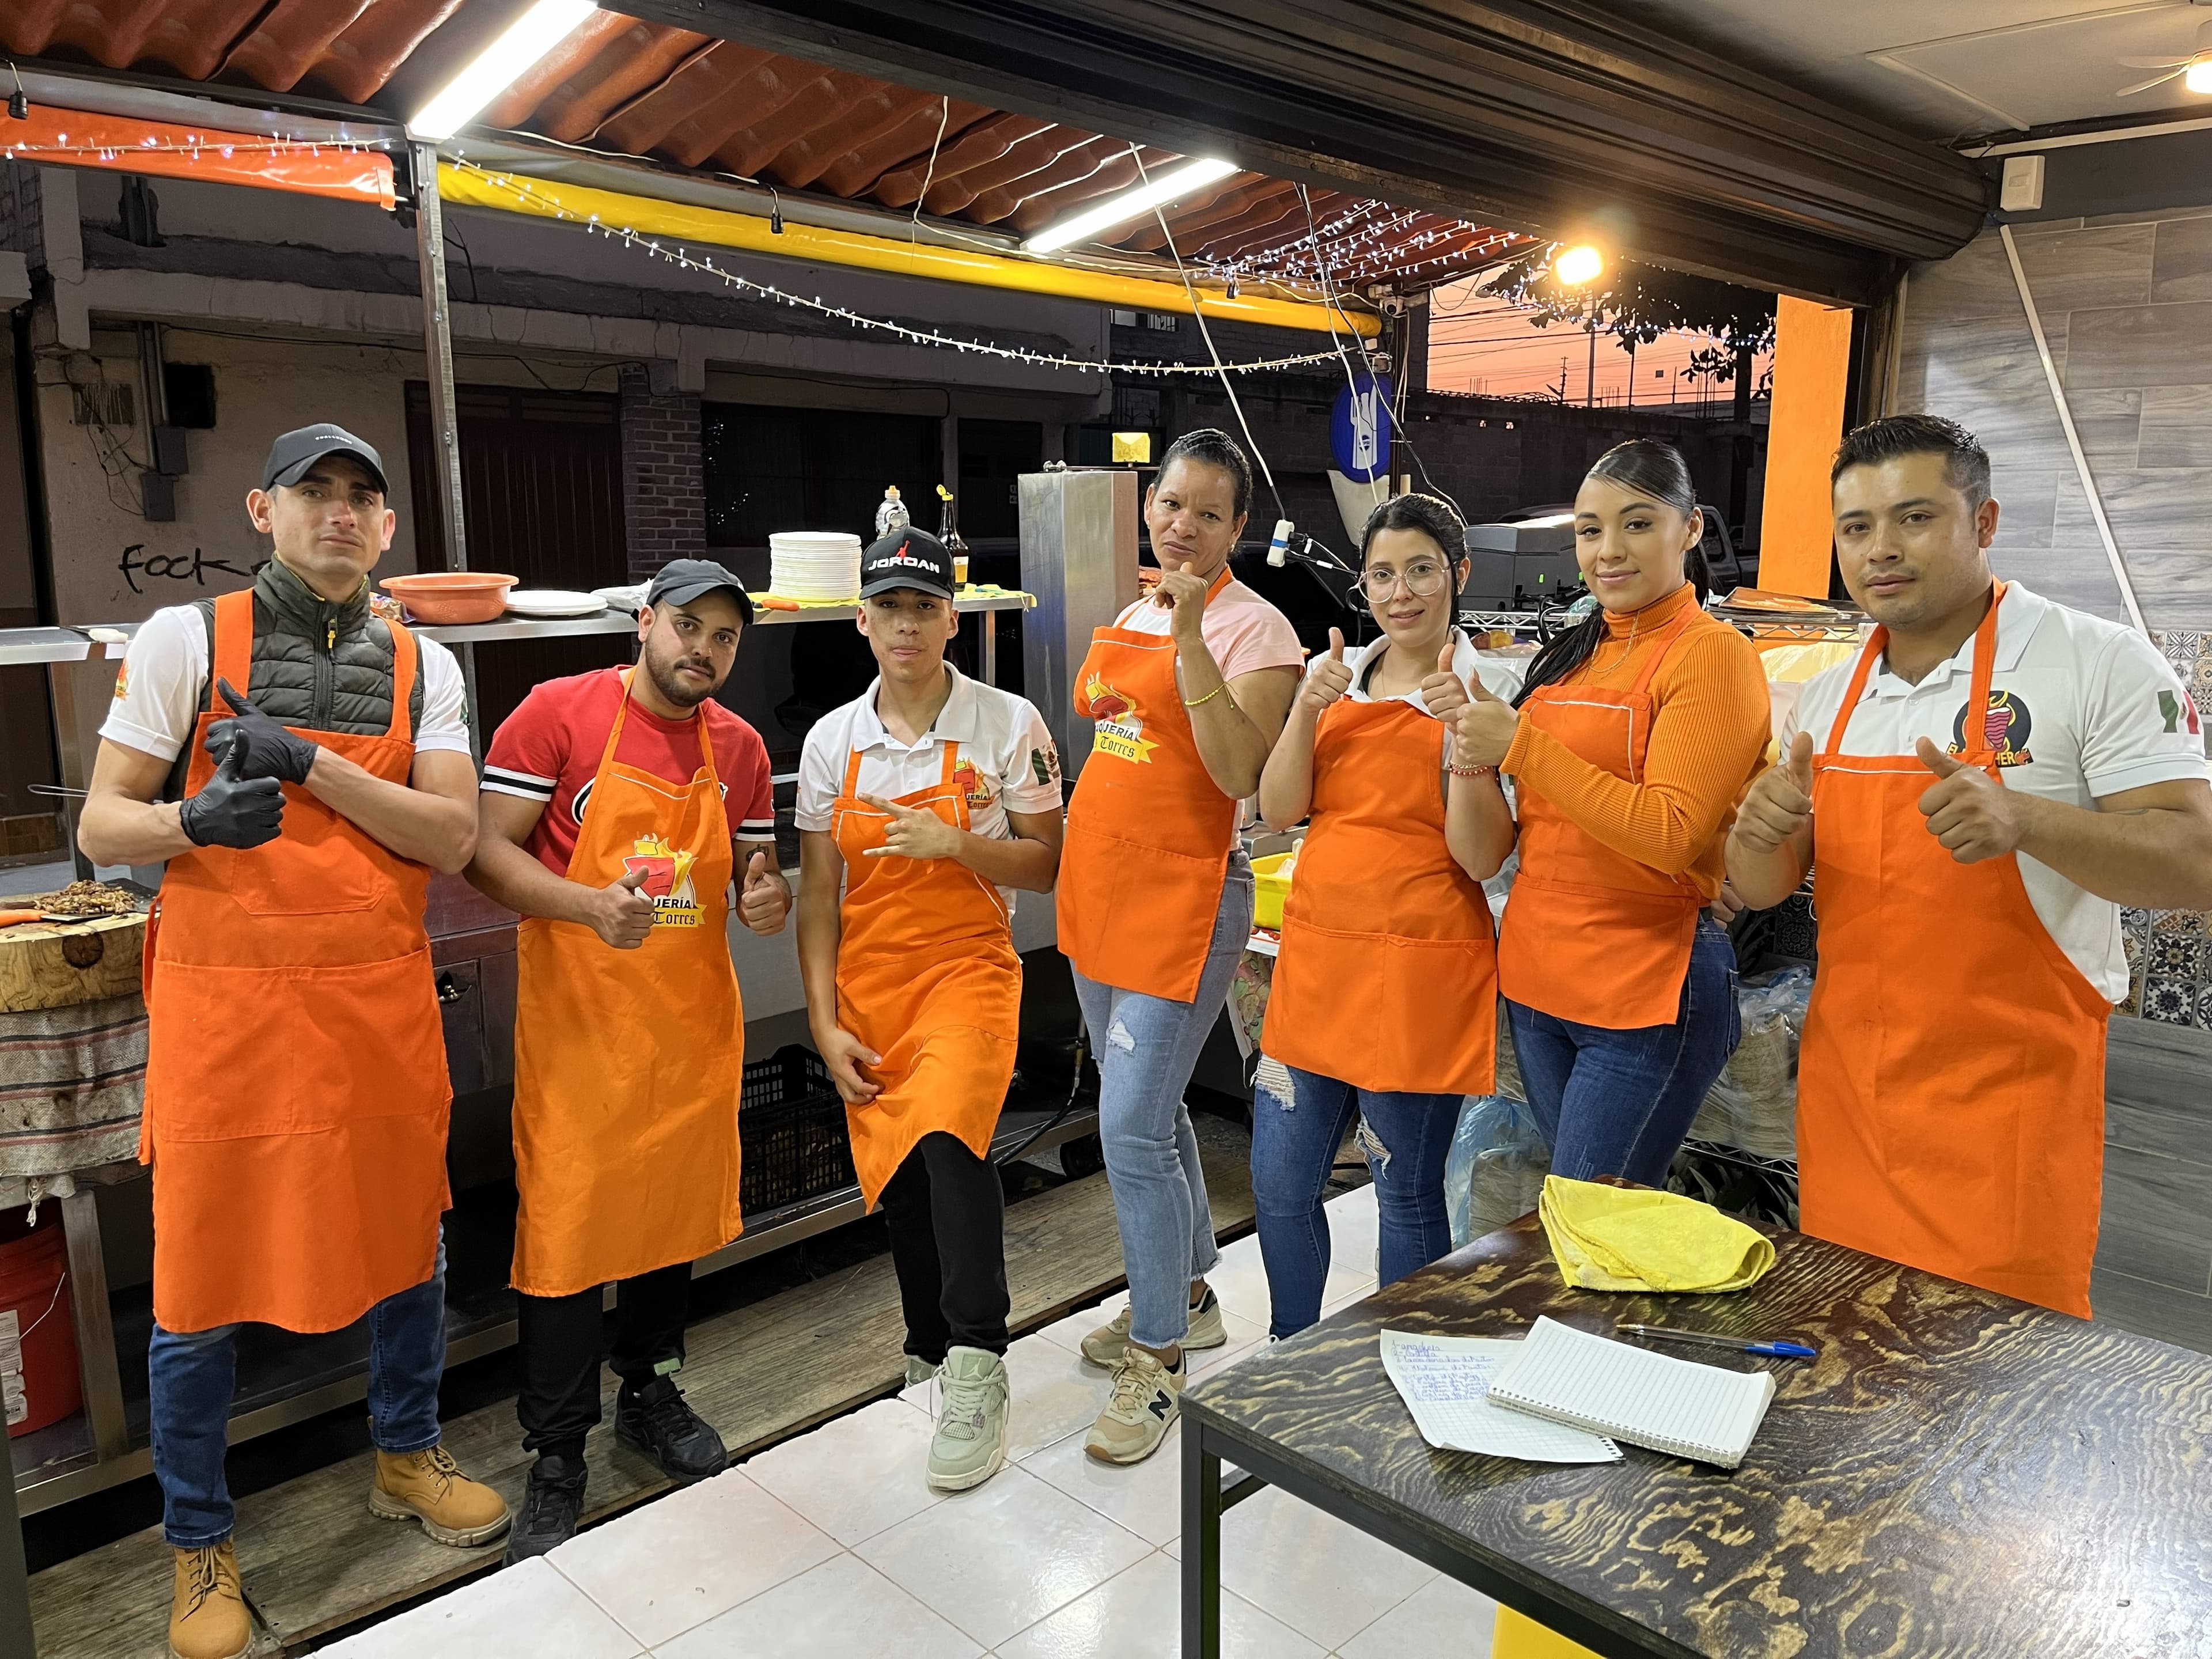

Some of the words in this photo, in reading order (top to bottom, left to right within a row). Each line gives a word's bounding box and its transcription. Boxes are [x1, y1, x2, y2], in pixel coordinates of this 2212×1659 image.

[868, 556, 940, 573] JORDAN
[1101, 736, 1135, 757] Torres
[654, 911, 695, 925] Torres
